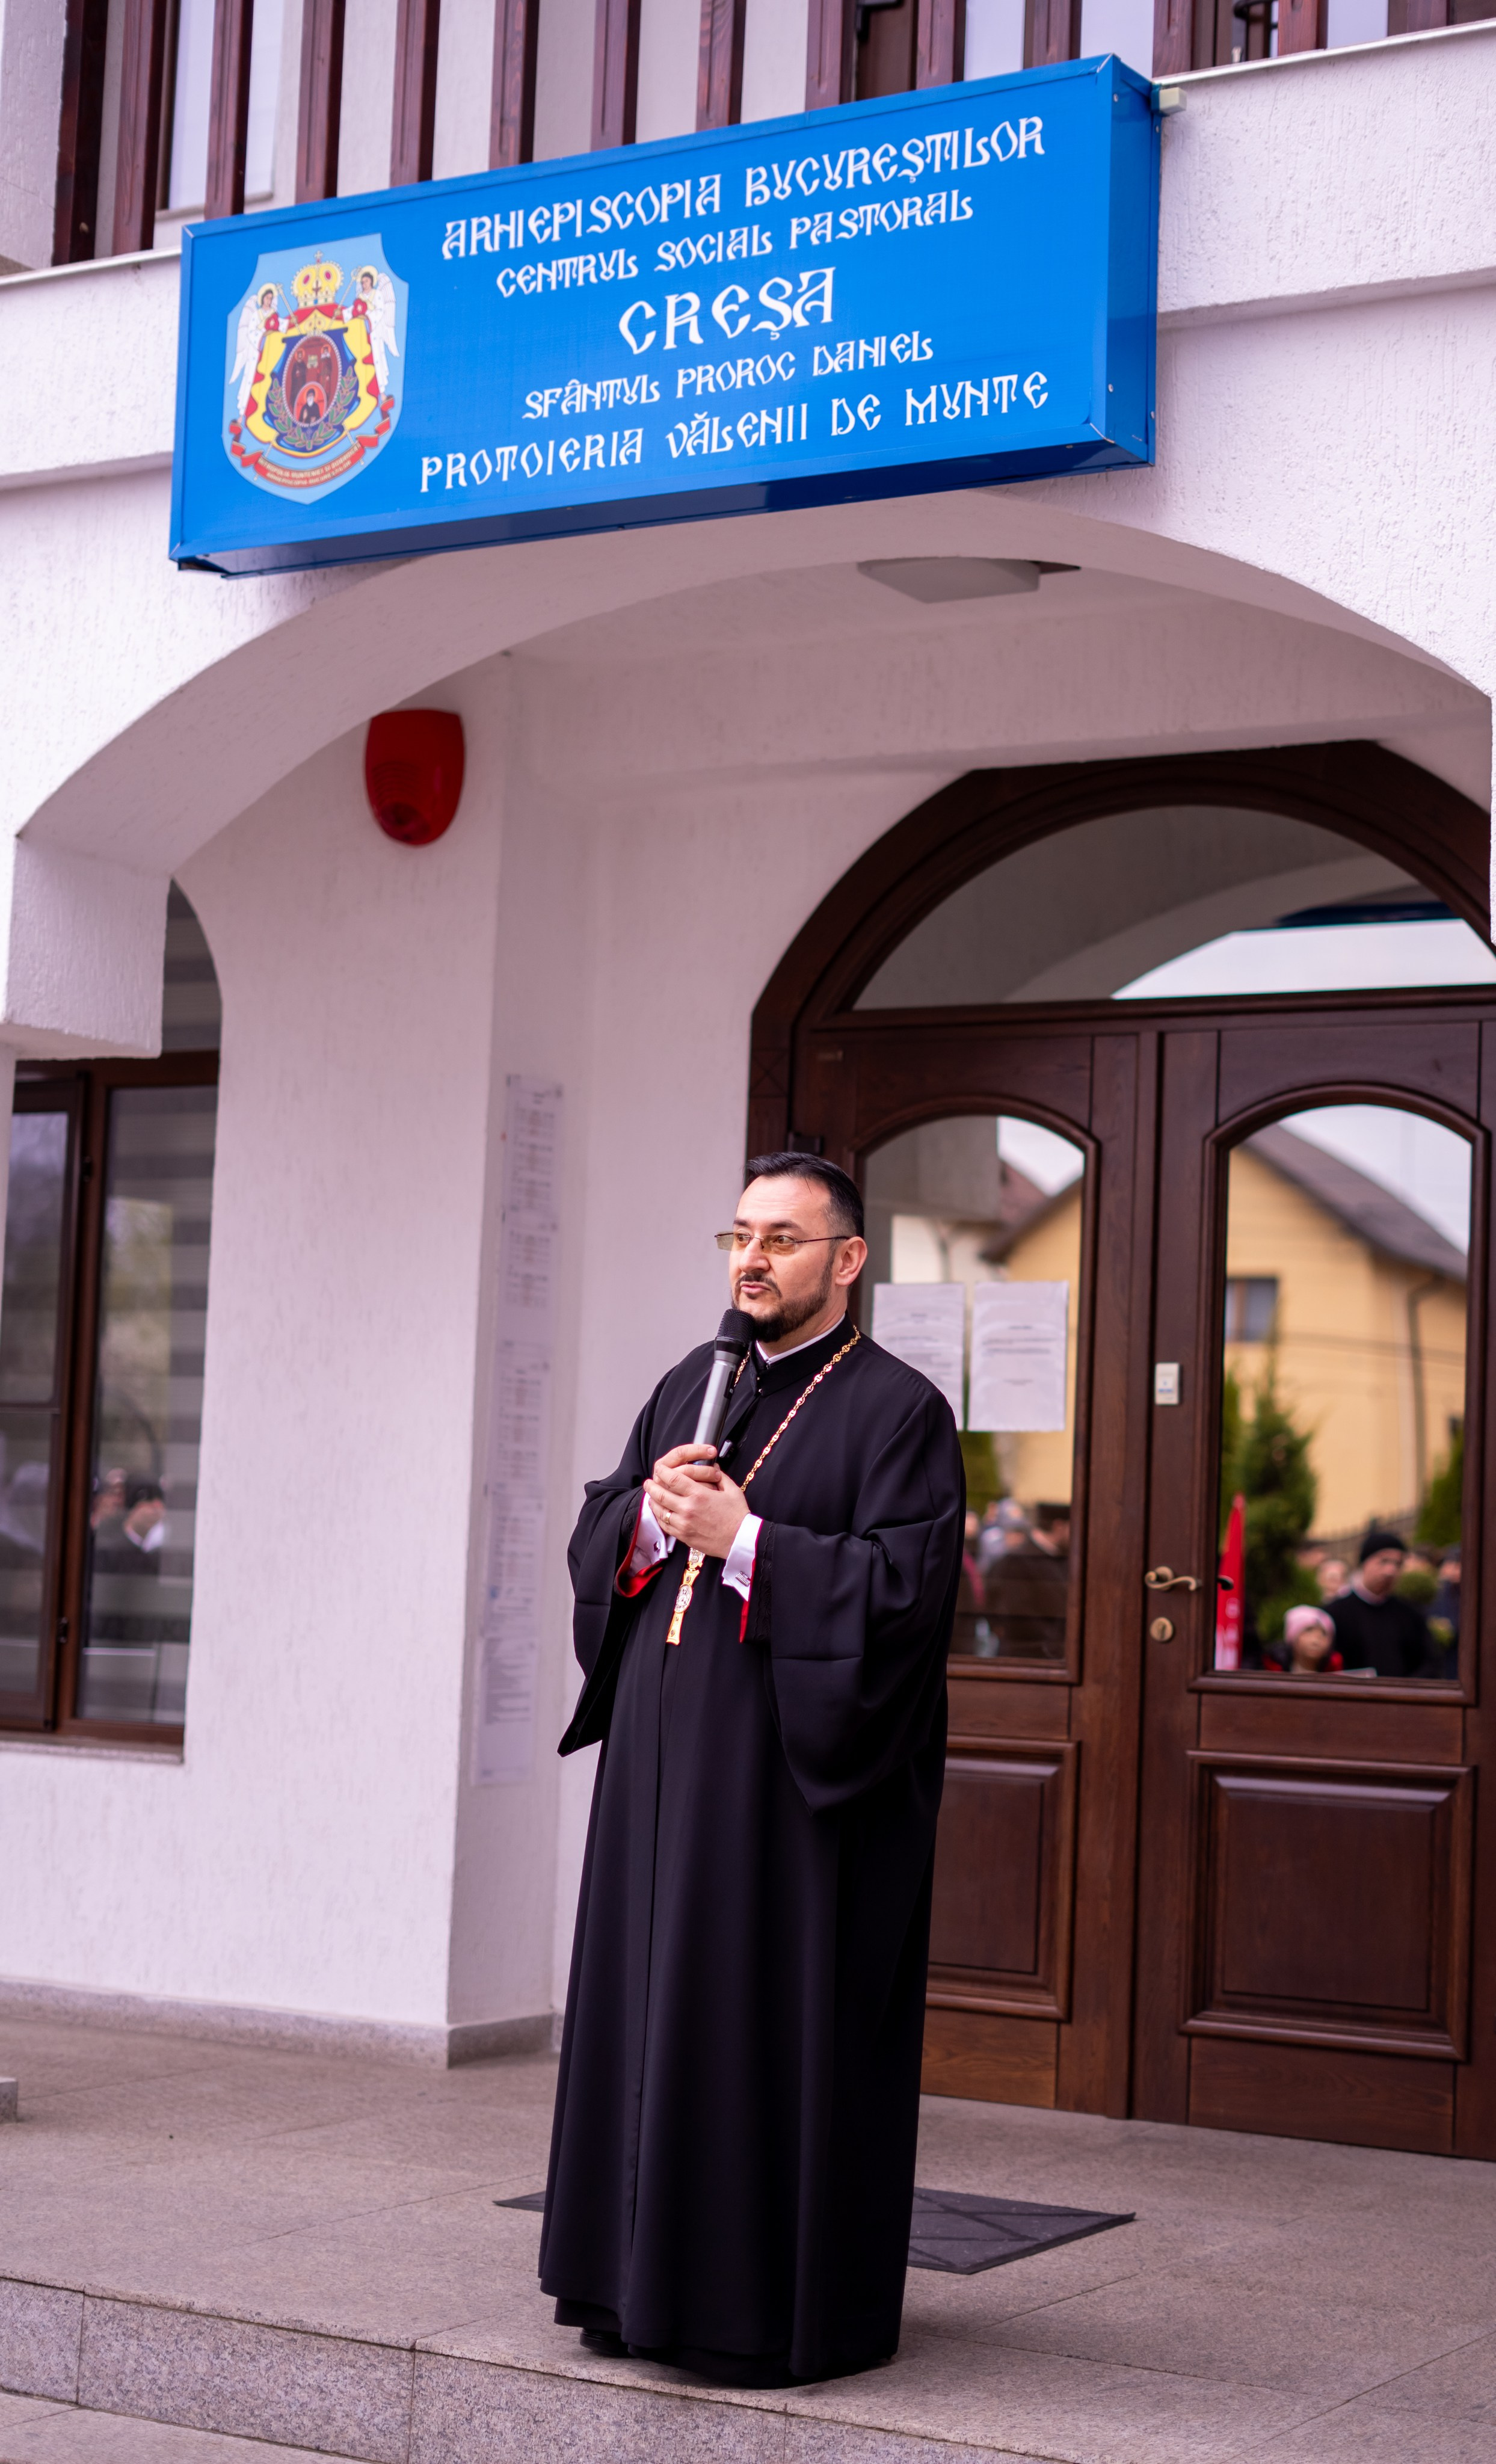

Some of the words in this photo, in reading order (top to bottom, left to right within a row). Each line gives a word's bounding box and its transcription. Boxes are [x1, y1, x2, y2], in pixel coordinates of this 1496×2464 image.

[442, 174, 721, 259] ARHIEPISCOPIA
[496, 248, 639, 297] CENTRUL
[654, 224, 773, 271] SOCIAL
[790, 189, 973, 249] PASTORAL
[618, 267, 836, 355] CREȘA
[522, 374, 660, 419] SFÂNTUL
[676, 351, 796, 399] PROROC
[812, 331, 934, 377] DANIEL
[420, 428, 644, 493] PROTOIERIA
[665, 403, 807, 459] VĂLENII
[831, 394, 881, 436] DE
[905, 371, 1048, 426] MUNTE
